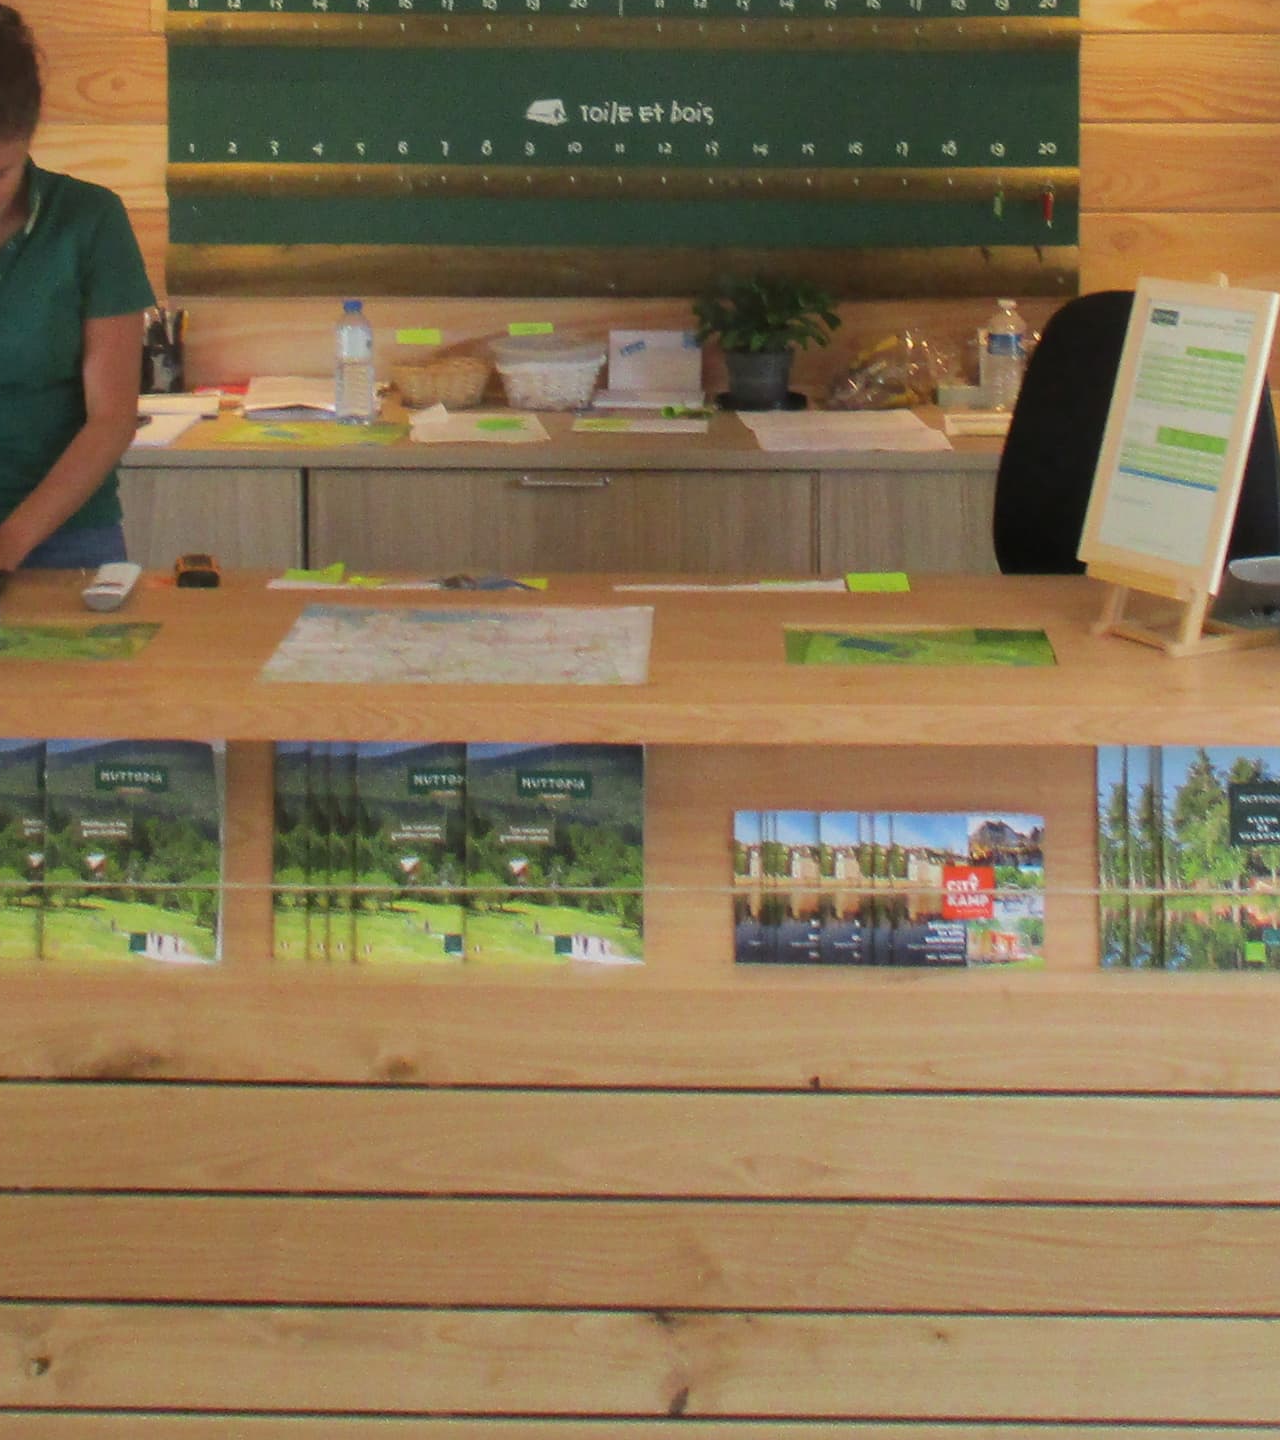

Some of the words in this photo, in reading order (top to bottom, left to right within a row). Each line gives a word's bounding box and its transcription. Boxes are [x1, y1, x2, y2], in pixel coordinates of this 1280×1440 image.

[670, 100, 715, 125] bois
[189, 142, 195, 154] 1
[228, 141, 237, 154] 2
[270, 140, 279, 156] 3
[312, 142, 323, 156] 4
[356, 142, 365, 155] 5
[397, 140, 408, 155] 6
[440, 140, 449, 157] 7
[481, 139, 493, 156] 8
[524, 141, 535, 156] 9
[567, 141, 583, 154] 10
[614, 142, 625, 154] 11
[658, 142, 672, 154] 12
[705, 140, 719, 156] 13
[752, 143, 769, 156] 14
[801, 142, 815, 155] 15
[848, 141, 863, 155] 16
[896, 141, 909, 157] 17
[941, 140, 958, 156] 18
[990, 142, 1006, 157] 19
[1038, 142, 1057, 155] 20
[521, 777, 586, 791] HUTTOPIA
[946, 879, 979, 892] CITY
[947, 894, 989, 908] KAMP
